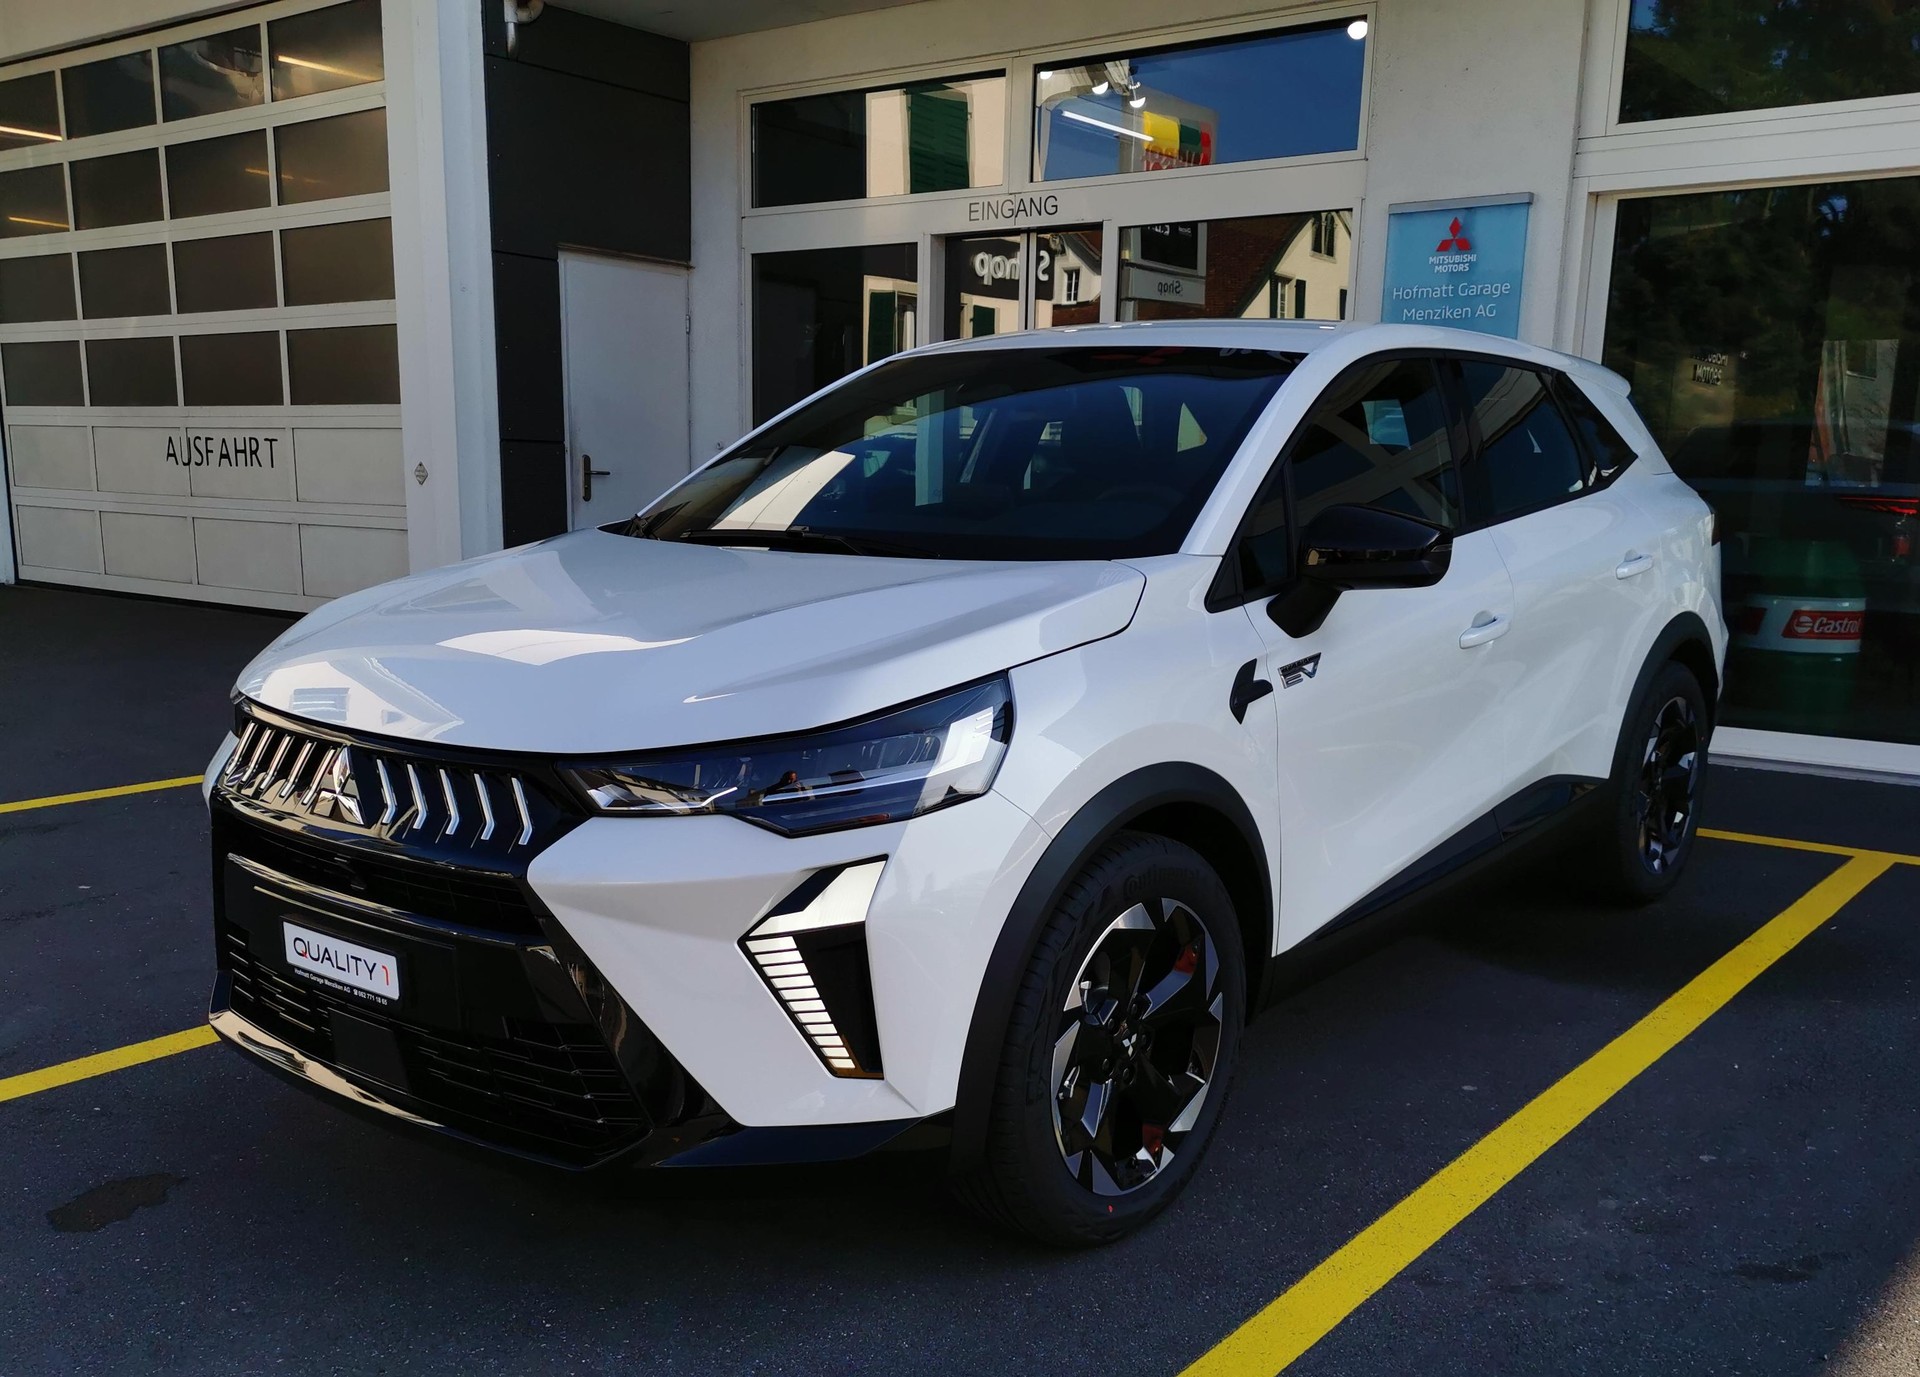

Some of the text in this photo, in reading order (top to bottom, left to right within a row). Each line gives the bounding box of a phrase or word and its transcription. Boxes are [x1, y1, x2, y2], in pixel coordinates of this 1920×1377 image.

[968, 195, 1059, 221] EINGANG
[1428, 254, 1477, 265] MITSUBISHI
[1434, 263, 1470, 273] MOTORS
[1392, 282, 1511, 300] Hofmatt Garage
[1402, 303, 1497, 321] Menziken AG
[166, 435, 278, 469] AUSFAHRT
[1813, 616, 1861, 634] Castrol
